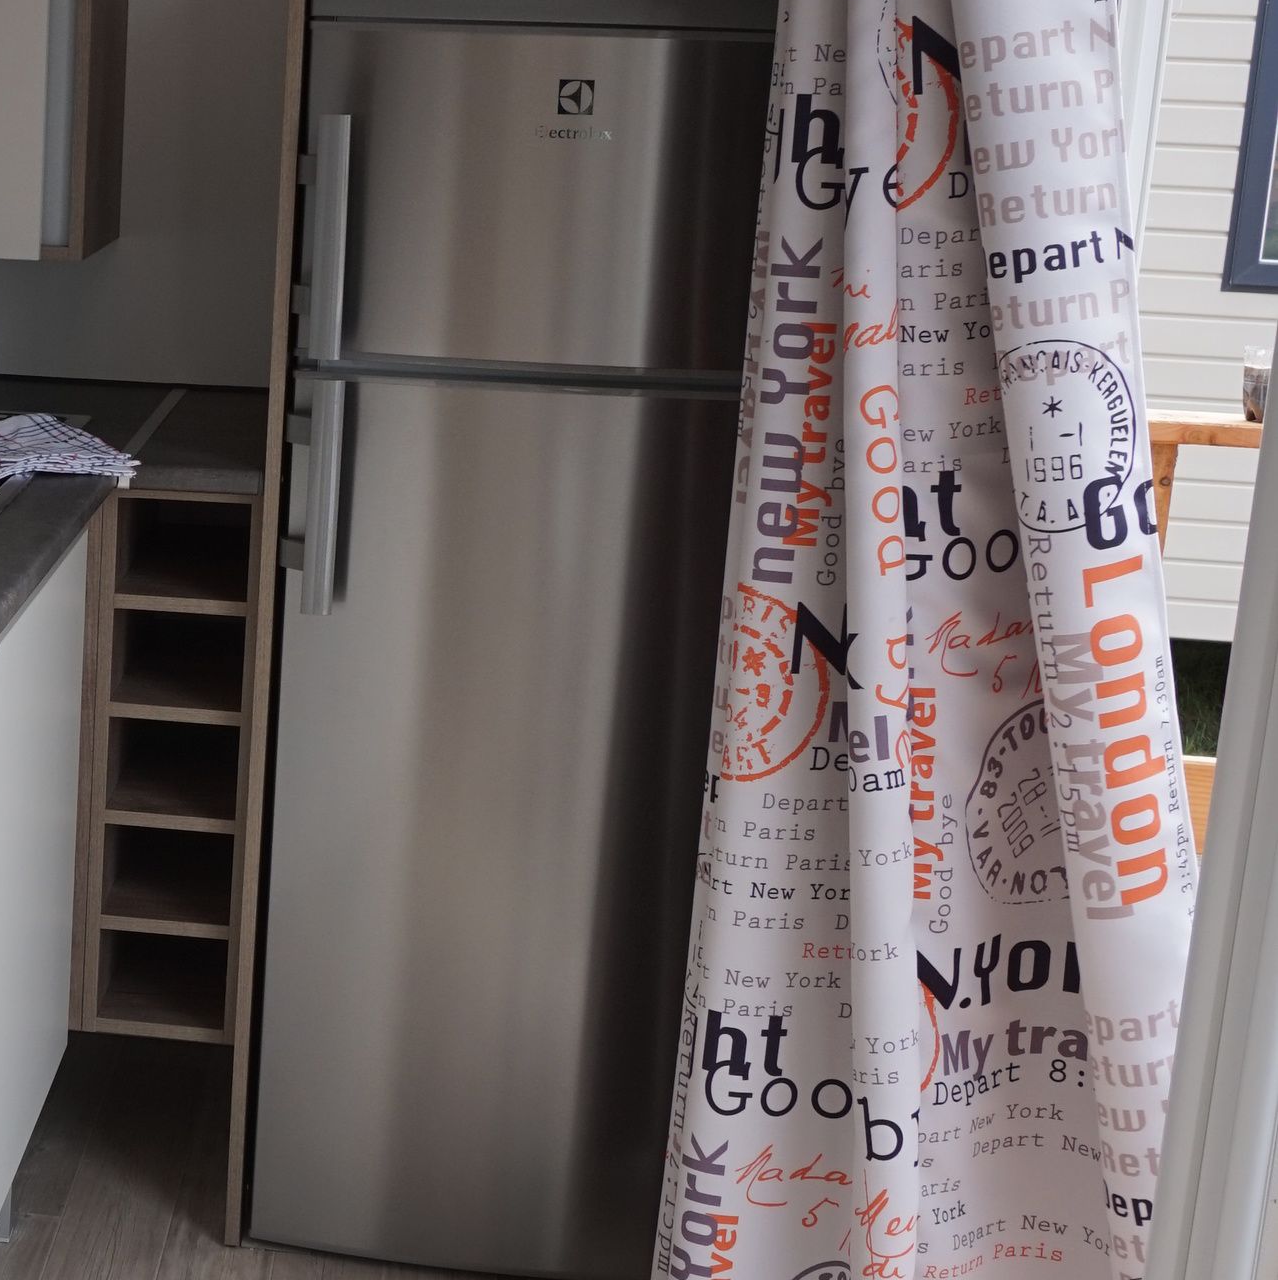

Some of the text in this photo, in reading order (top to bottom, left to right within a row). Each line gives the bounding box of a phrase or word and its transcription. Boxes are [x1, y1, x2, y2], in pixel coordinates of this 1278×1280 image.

[960, 20, 1076, 72] epart
[965, 78, 1083, 122] eturn
[973, 120, 1125, 175] ew Yor
[978, 182, 1118, 228] Return
[899, 226, 980, 251] Depar
[900, 258, 963, 279] aris
[988, 229, 1105, 284] epart
[933, 287, 990, 312] Pari
[991, 287, 1100, 333] eturn
[900, 324, 950, 344] New
[901, 357, 965, 378] aris
[903, 427, 935, 444] ew
[902, 455, 964, 475] aris
[816, 513, 843, 586] Good
[1026, 534, 1060, 683] Return
[1082, 554, 1168, 906] London
[1168, 739, 1182, 815] Return
[762, 793, 850, 816] Depart
[742, 820, 816, 842] Paris
[858, 840, 912, 868] York
[928, 793, 958, 935] Good bye
[749, 881, 850, 902] New Yor
[731, 910, 805, 931] Paris
[723, 969, 842, 990] New York
[722, 997, 793, 1019] Paris
[865, 1028, 920, 1055] York
[941, 1029, 995, 1081] My
[932, 1062, 1021, 1106] Depart
[969, 1112, 996, 1135] New
[1005, 1103, 1065, 1122] York
[1097, 1102, 1147, 1133] ew
[971, 1132, 1045, 1158] Depart
[921, 1177, 962, 1198] aris
[931, 1199, 967, 1225] York
[952, 1218, 1006, 1252] Depart
[1021, 1214, 1069, 1236] New
[922, 1241, 1064, 1280] Return Paris
